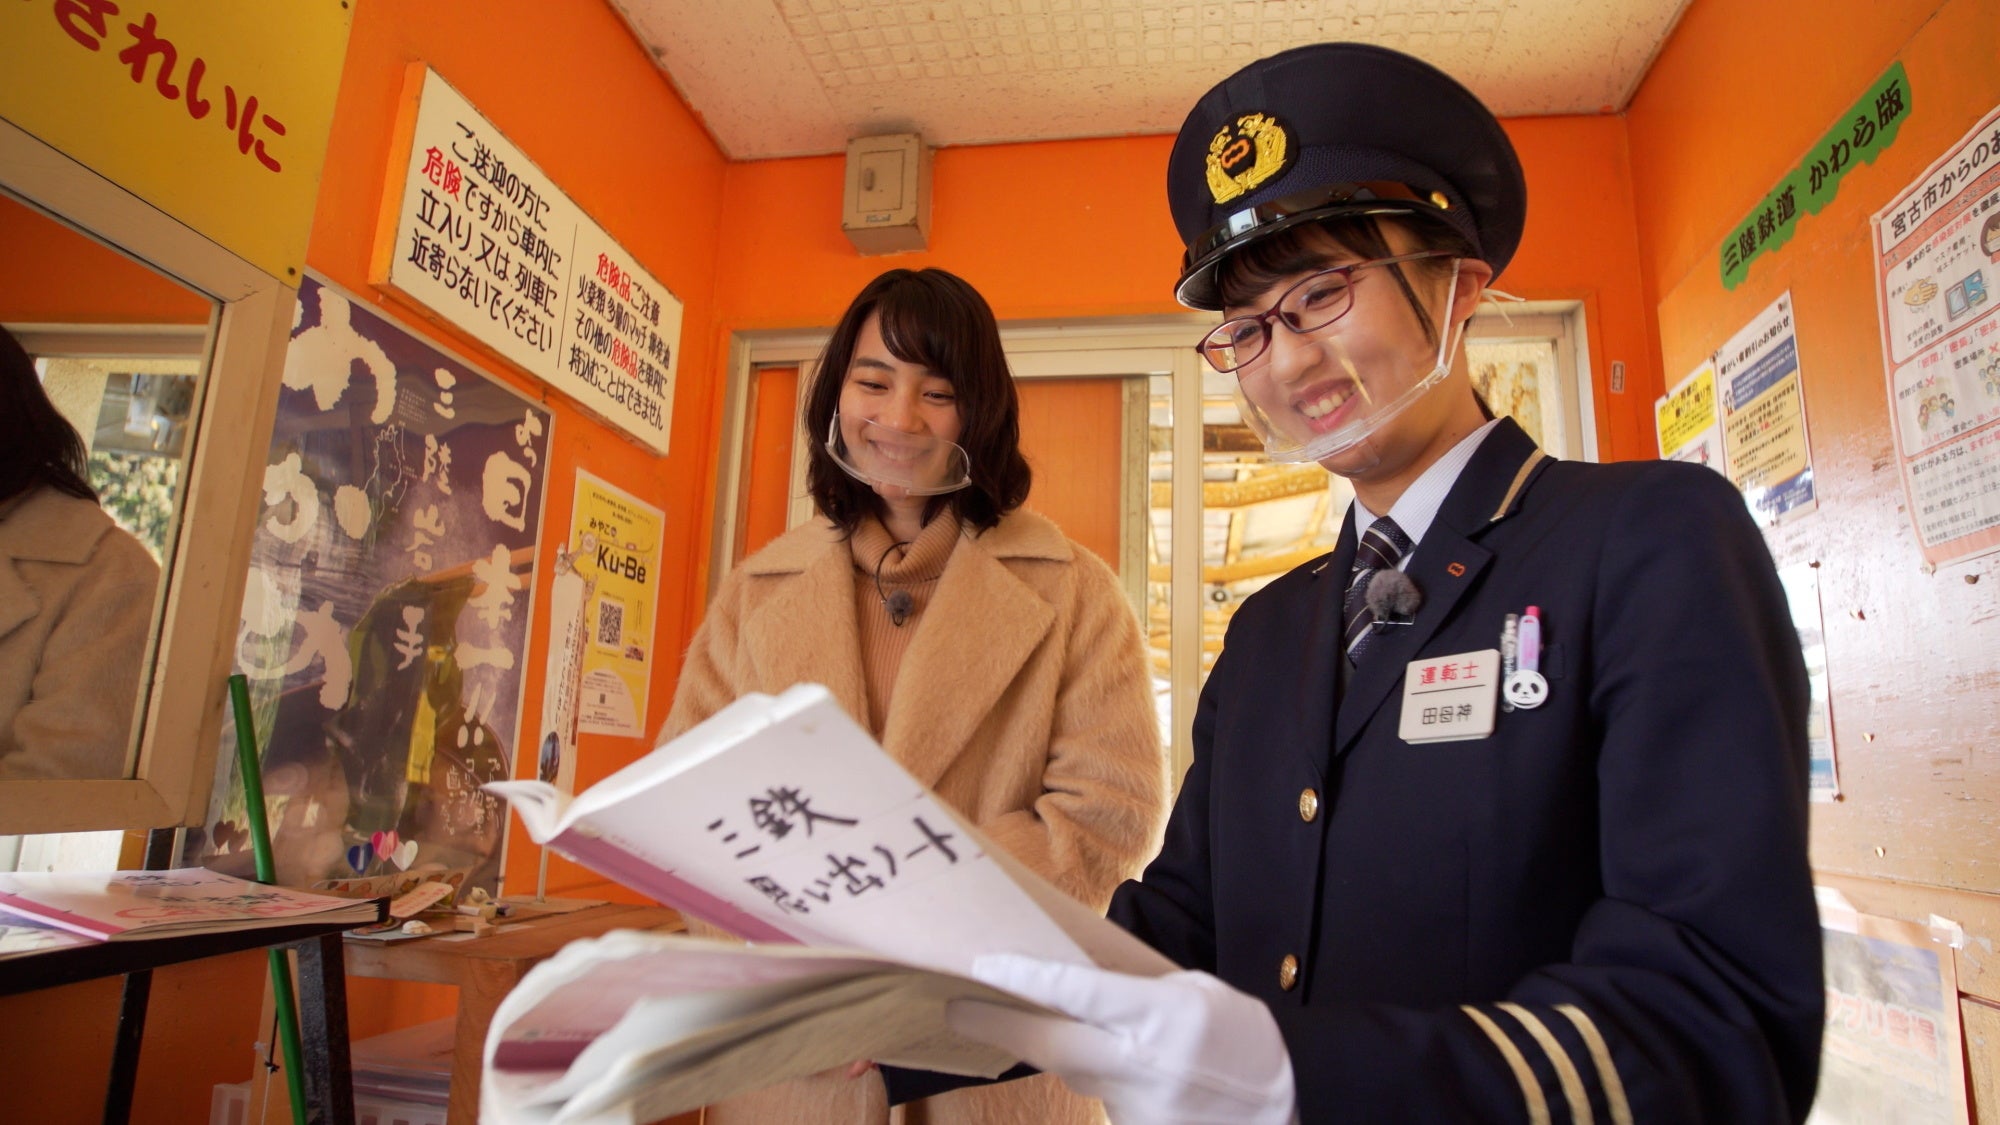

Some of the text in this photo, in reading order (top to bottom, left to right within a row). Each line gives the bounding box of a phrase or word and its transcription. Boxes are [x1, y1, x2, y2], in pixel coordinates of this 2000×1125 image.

[421, 146, 562, 280] 危険ですから車内に
[451, 121, 550, 231] ご送迎の方に
[1724, 183, 1797, 277] 三陸鉄道
[1808, 79, 1905, 195] かわら版
[408, 228, 553, 352] 近寄らないでください
[596, 252, 660, 327] 危険品ご注意
[568, 343, 664, 432] 持込むことはできません
[575, 308, 668, 400] その他の危険品を車内に
[597, 543, 647, 585] Ku-Be
[1420, 660, 1480, 687] 運転士
[1421, 703, 1473, 726] 田母神
[707, 786, 860, 860] 三鉄
[744, 815, 959, 914] 思い出ノート
